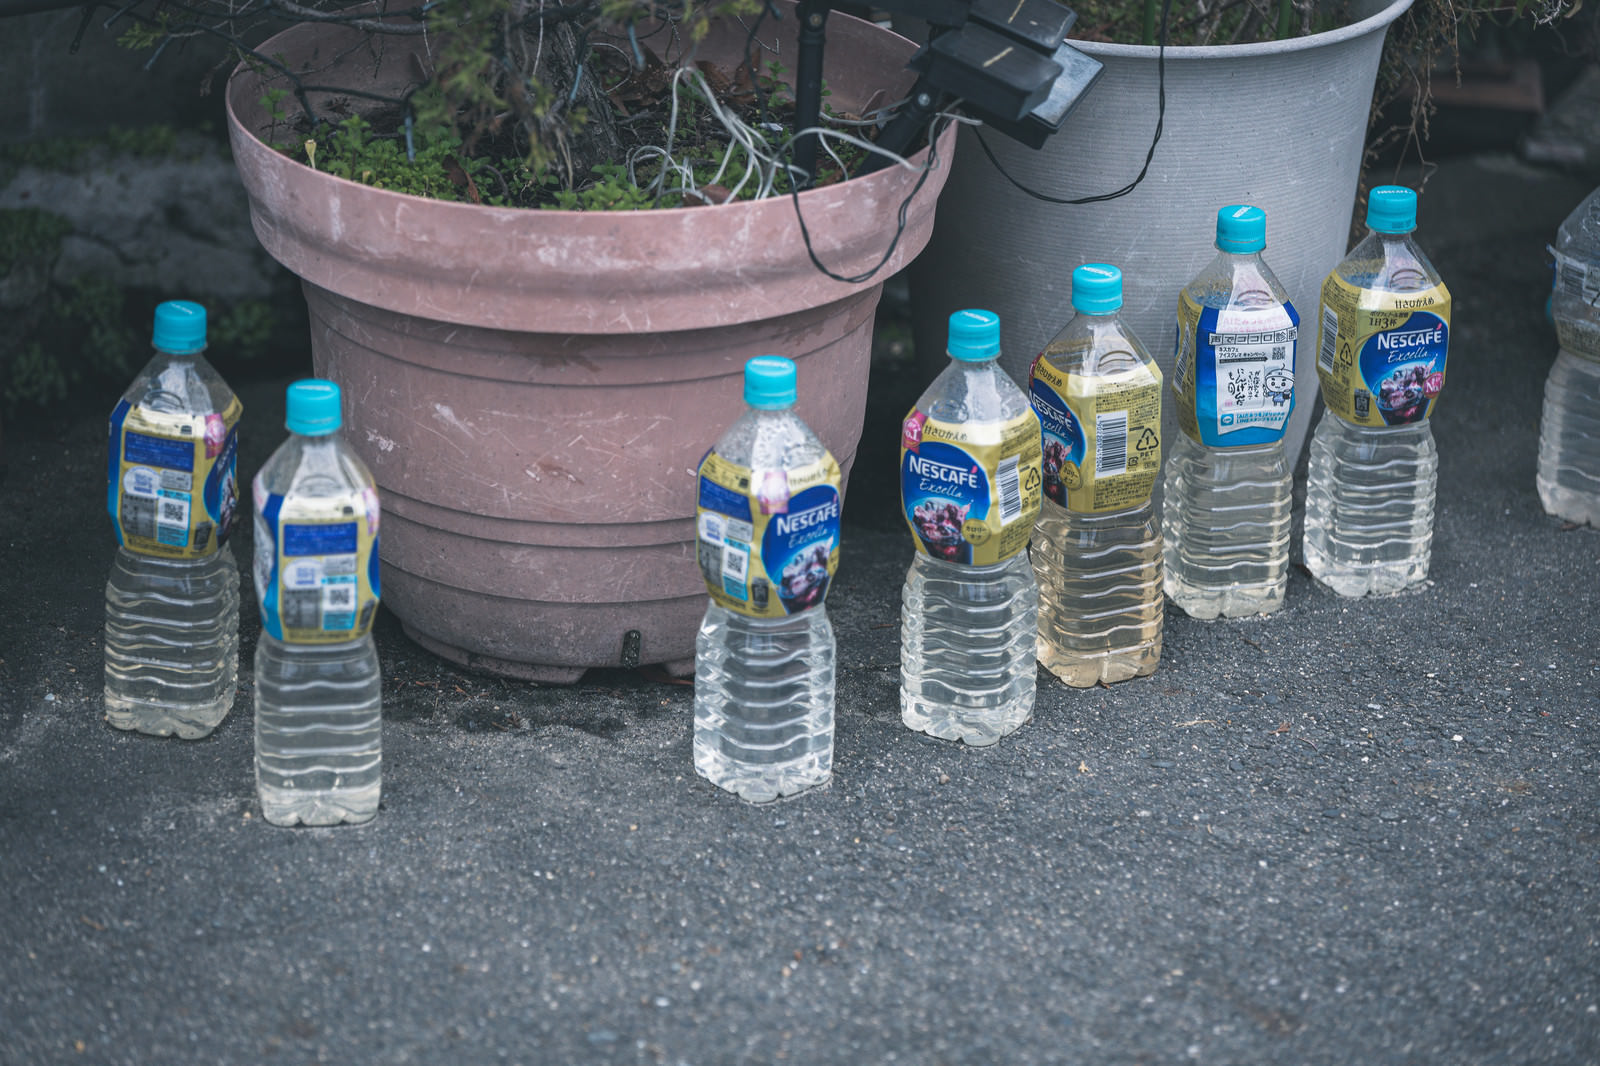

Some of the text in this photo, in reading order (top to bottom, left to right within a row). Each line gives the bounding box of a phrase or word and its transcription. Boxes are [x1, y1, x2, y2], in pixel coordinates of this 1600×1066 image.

[1210, 328, 1297, 345] 声でココロ診断
[1377, 322, 1443, 350] NESCAFÉ
[1387, 347, 1429, 363] Excella
[1140, 450, 1154, 458] PET
[910, 455, 978, 488] NESCAFÉ
[920, 477, 964, 498] Excella
[776, 493, 838, 536] NESCAFÉ
